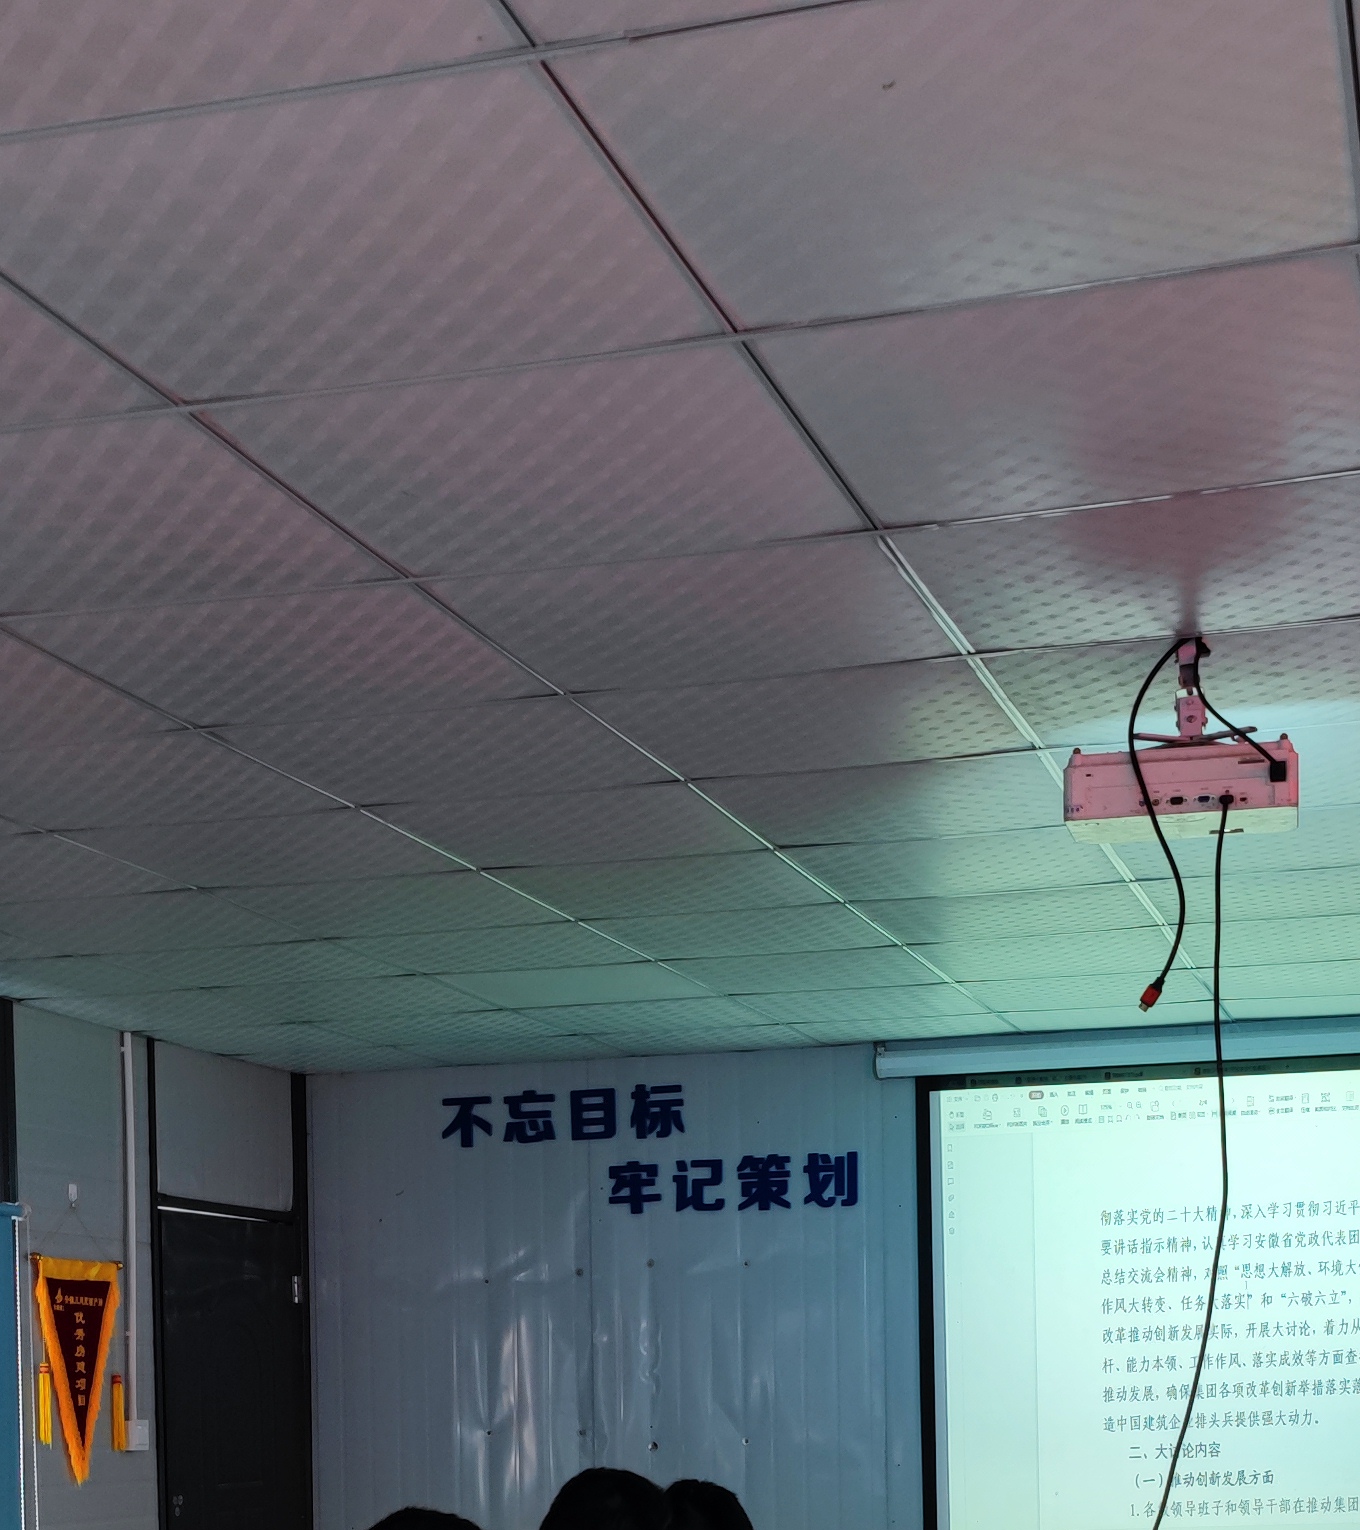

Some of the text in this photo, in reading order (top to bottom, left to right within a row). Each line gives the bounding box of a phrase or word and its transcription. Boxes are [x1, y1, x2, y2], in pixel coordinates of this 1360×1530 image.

[441, 1084, 685, 1148] 不忘目标
[608, 1151, 859, 1214] 牢记策划
[1102, 1408, 1320, 1433] 造中国建筑企排头兵提供强大动力。
